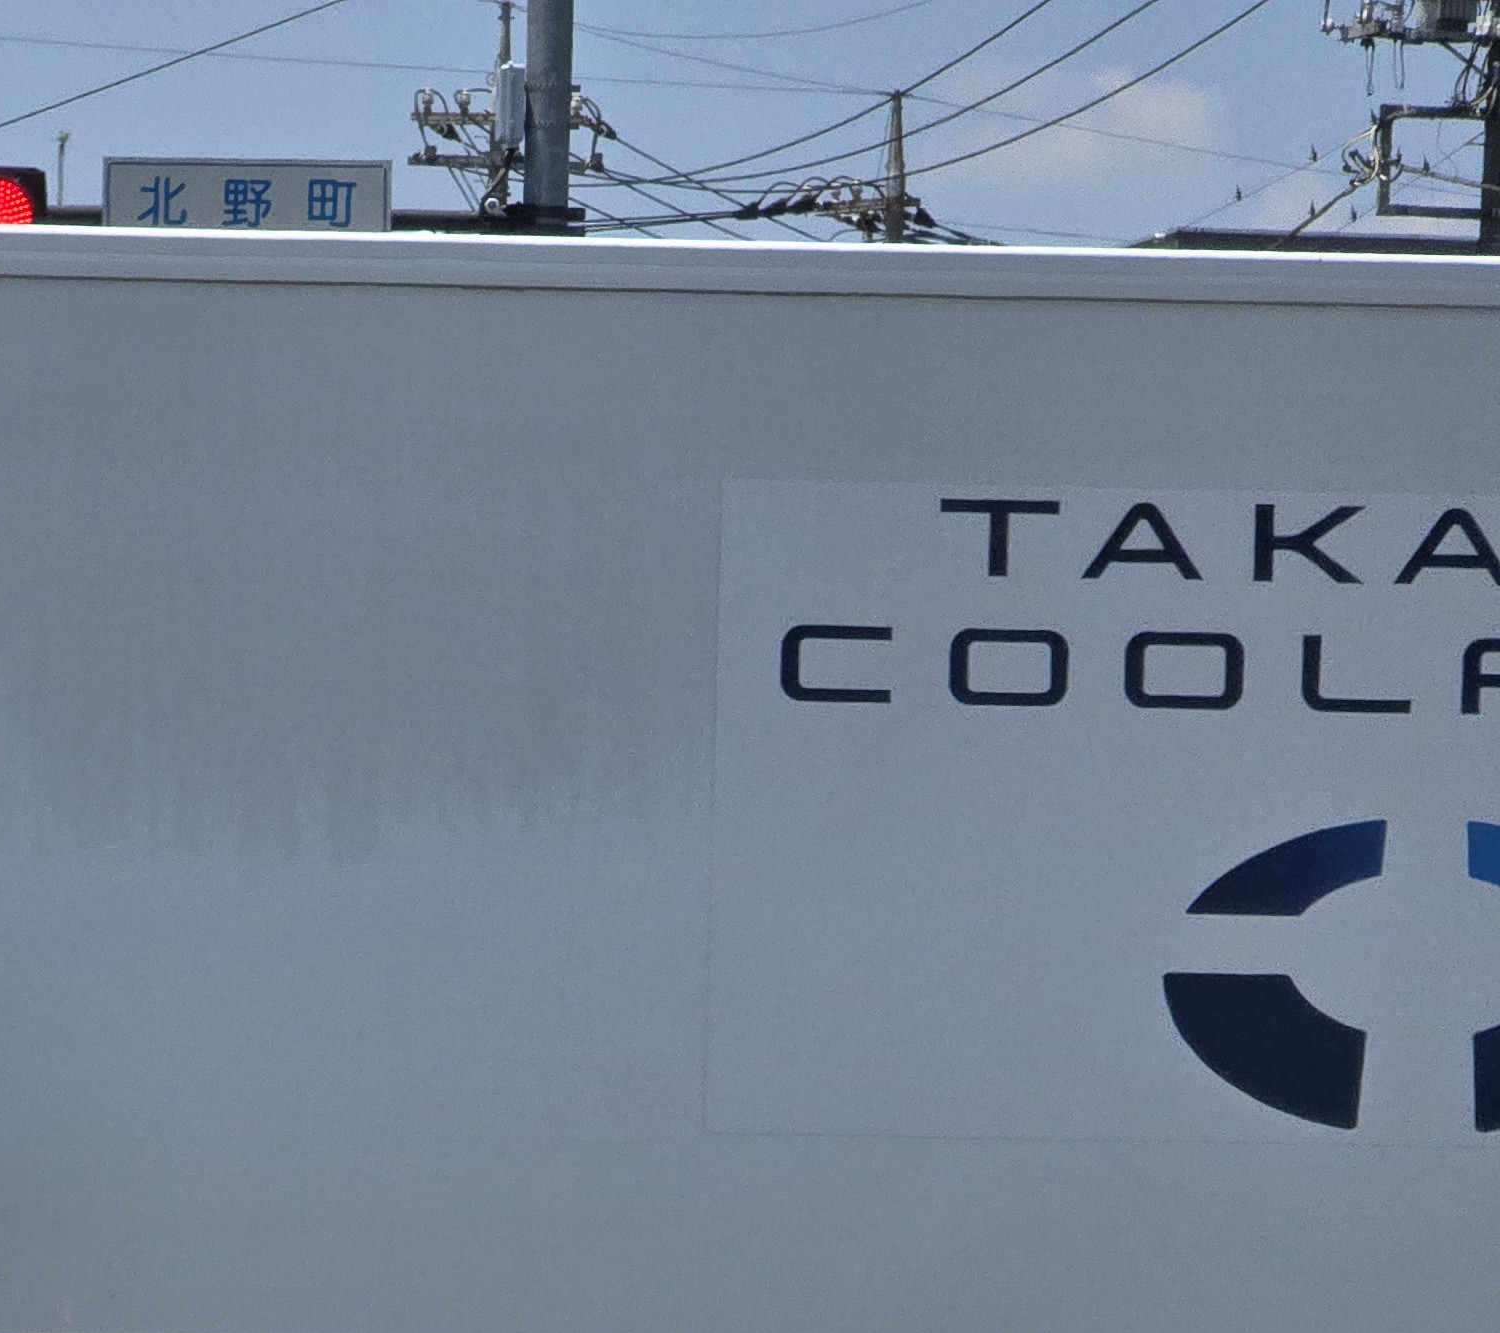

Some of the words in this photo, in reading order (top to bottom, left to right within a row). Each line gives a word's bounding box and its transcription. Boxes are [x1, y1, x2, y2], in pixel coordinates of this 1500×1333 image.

[136, 175, 357, 229] 北野町
[939, 497, 1500, 585] TAKA
